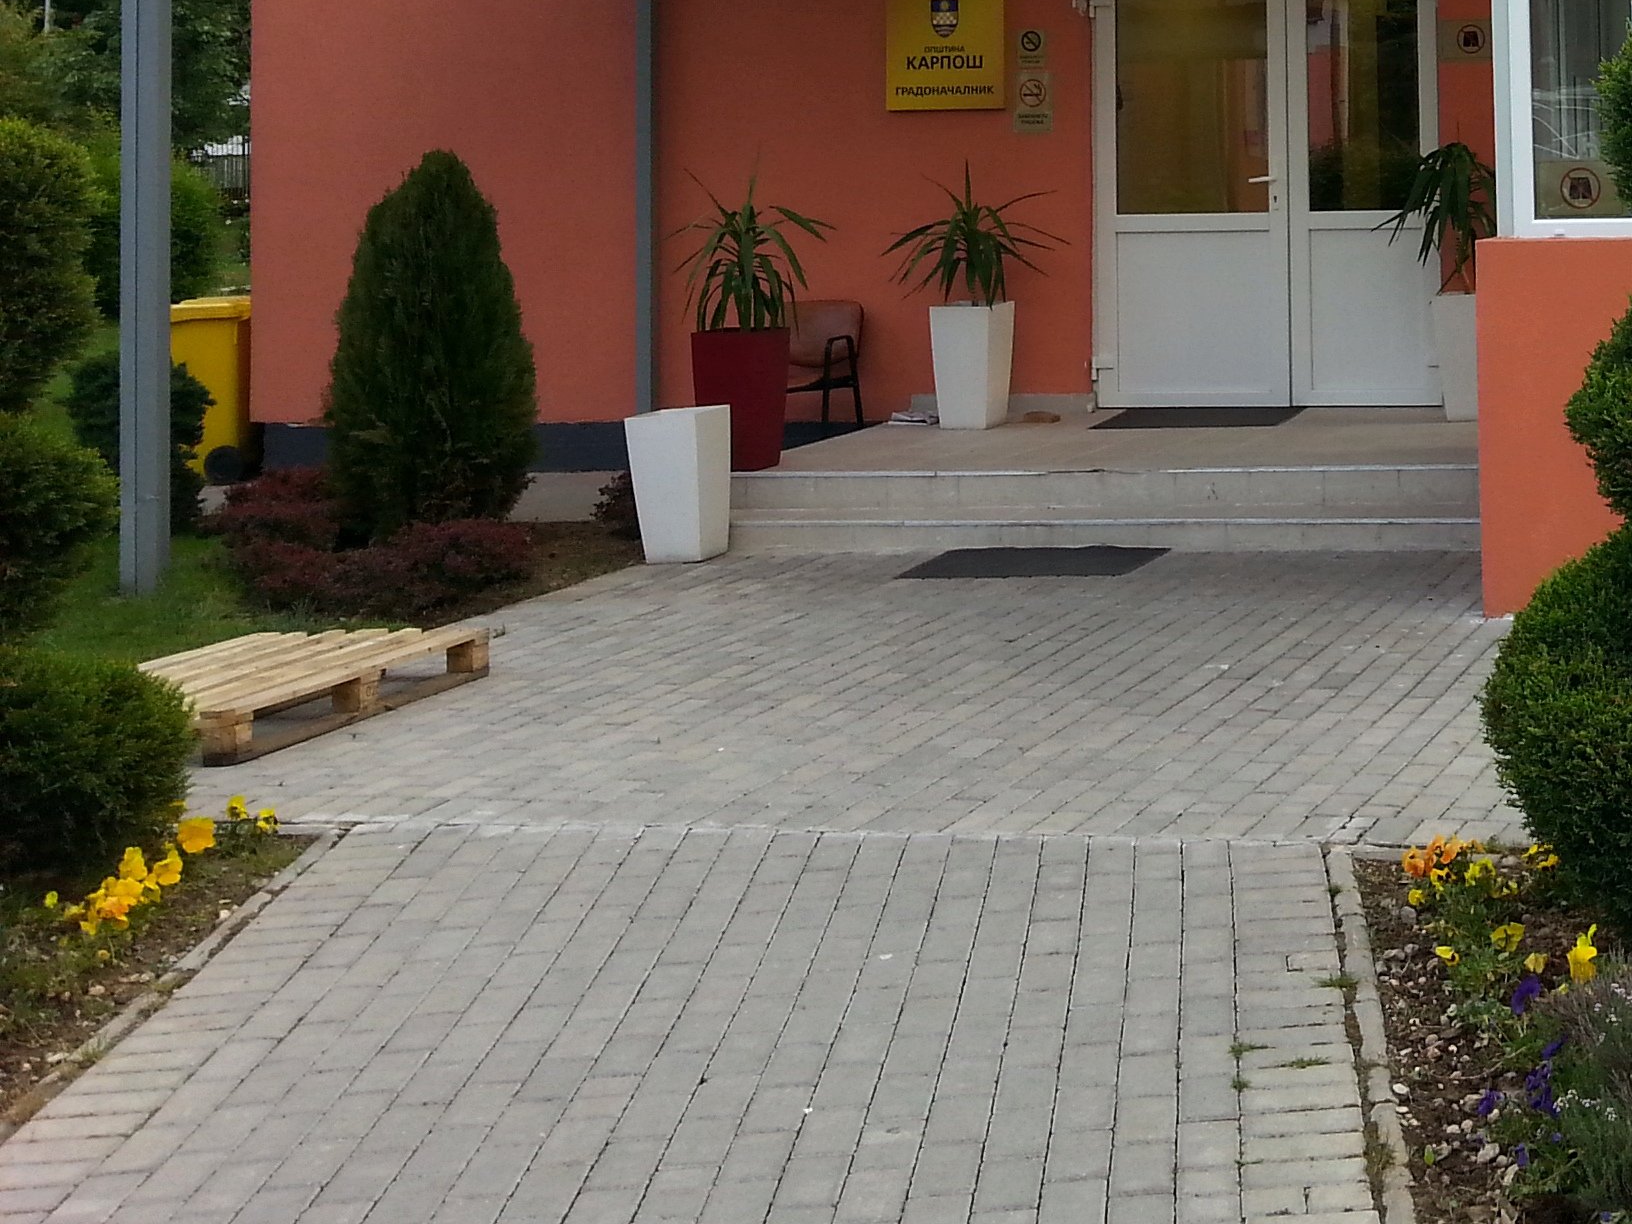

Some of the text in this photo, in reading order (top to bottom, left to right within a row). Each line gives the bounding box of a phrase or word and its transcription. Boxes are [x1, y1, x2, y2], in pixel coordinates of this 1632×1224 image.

[924, 45, 965, 53] ОПШТИНА
[906, 55, 983, 70] КАРПОШ
[896, 85, 994, 97] ГРАДОНАЧАЛНИК
